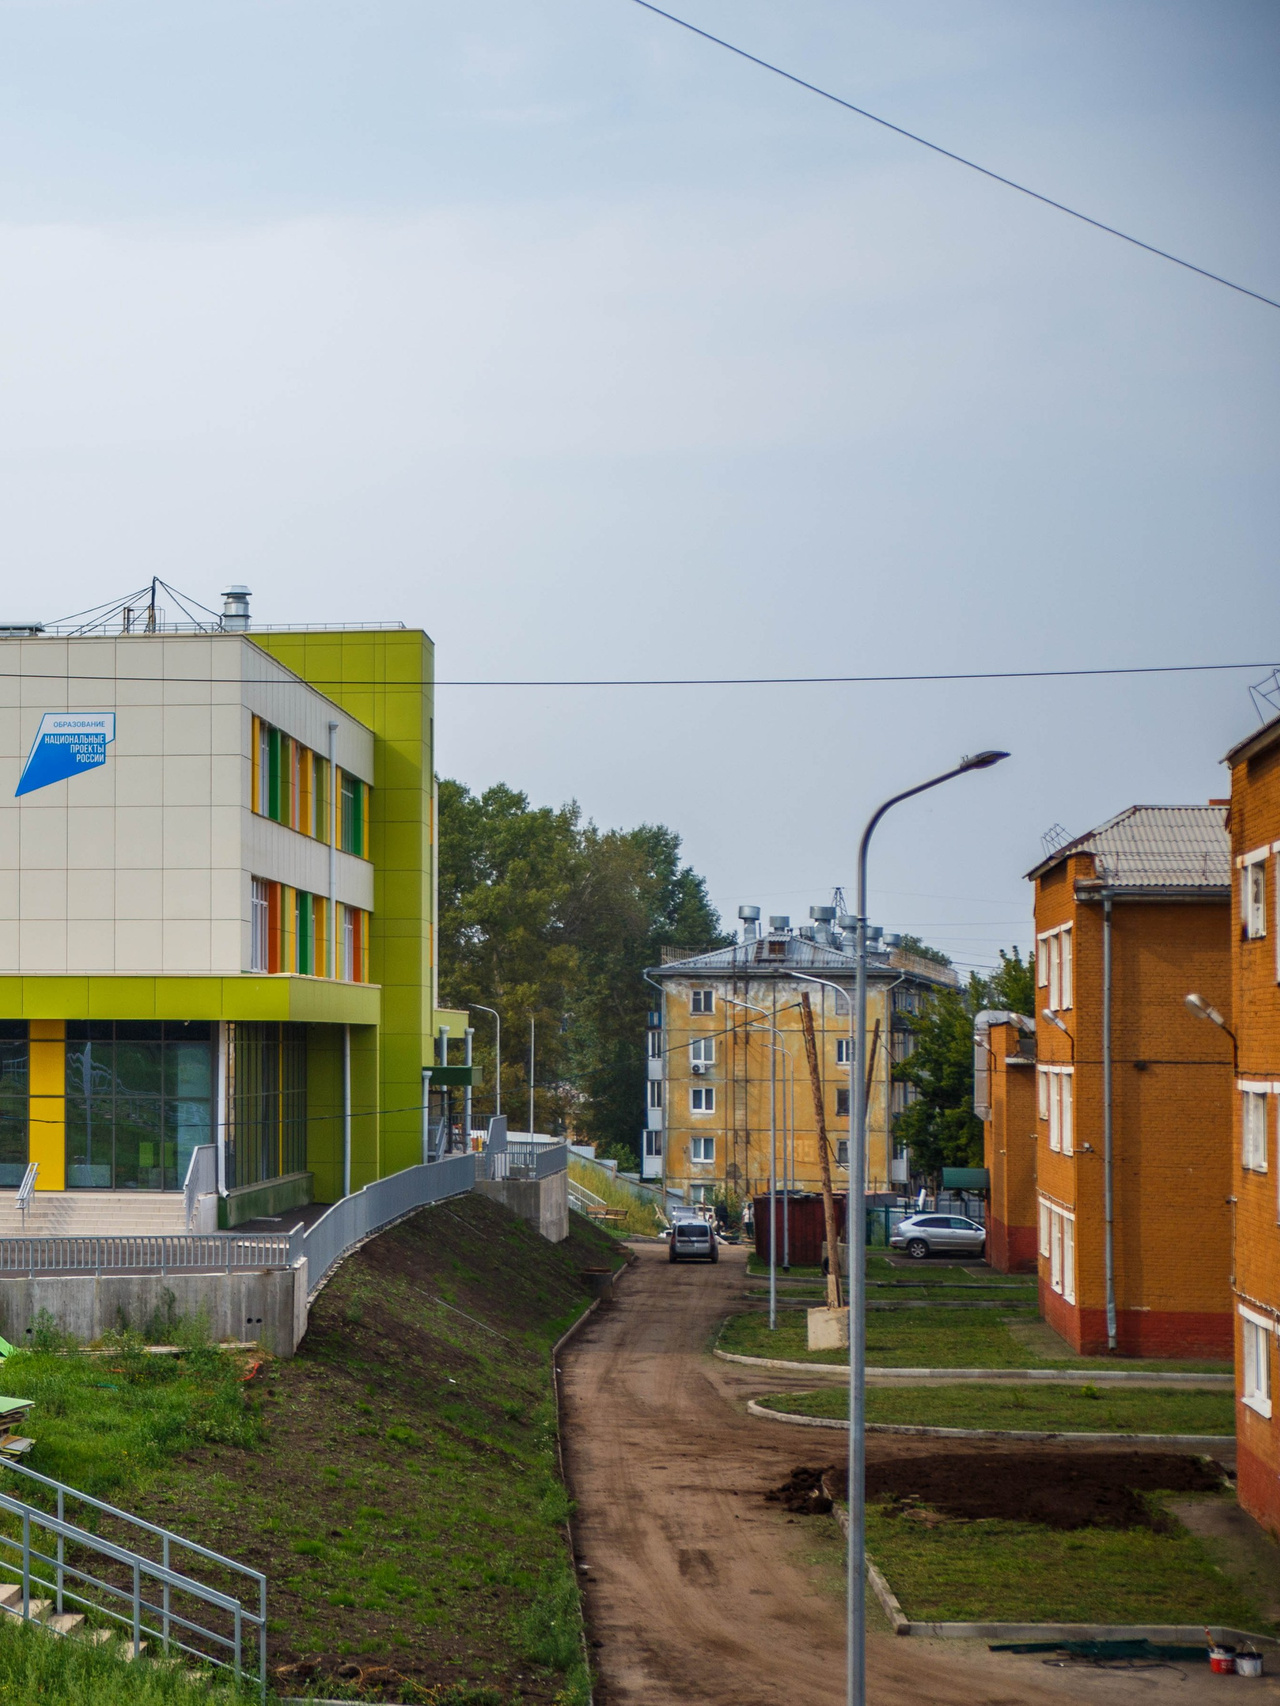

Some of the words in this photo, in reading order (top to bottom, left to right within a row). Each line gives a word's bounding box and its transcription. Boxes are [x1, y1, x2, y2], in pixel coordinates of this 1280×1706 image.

[45, 735, 104, 744] НАЦИОНАЛЬНЫЕ
[70, 745, 104, 753] ПРОЕКТЫ
[76, 754, 104, 762] РОССИИ
